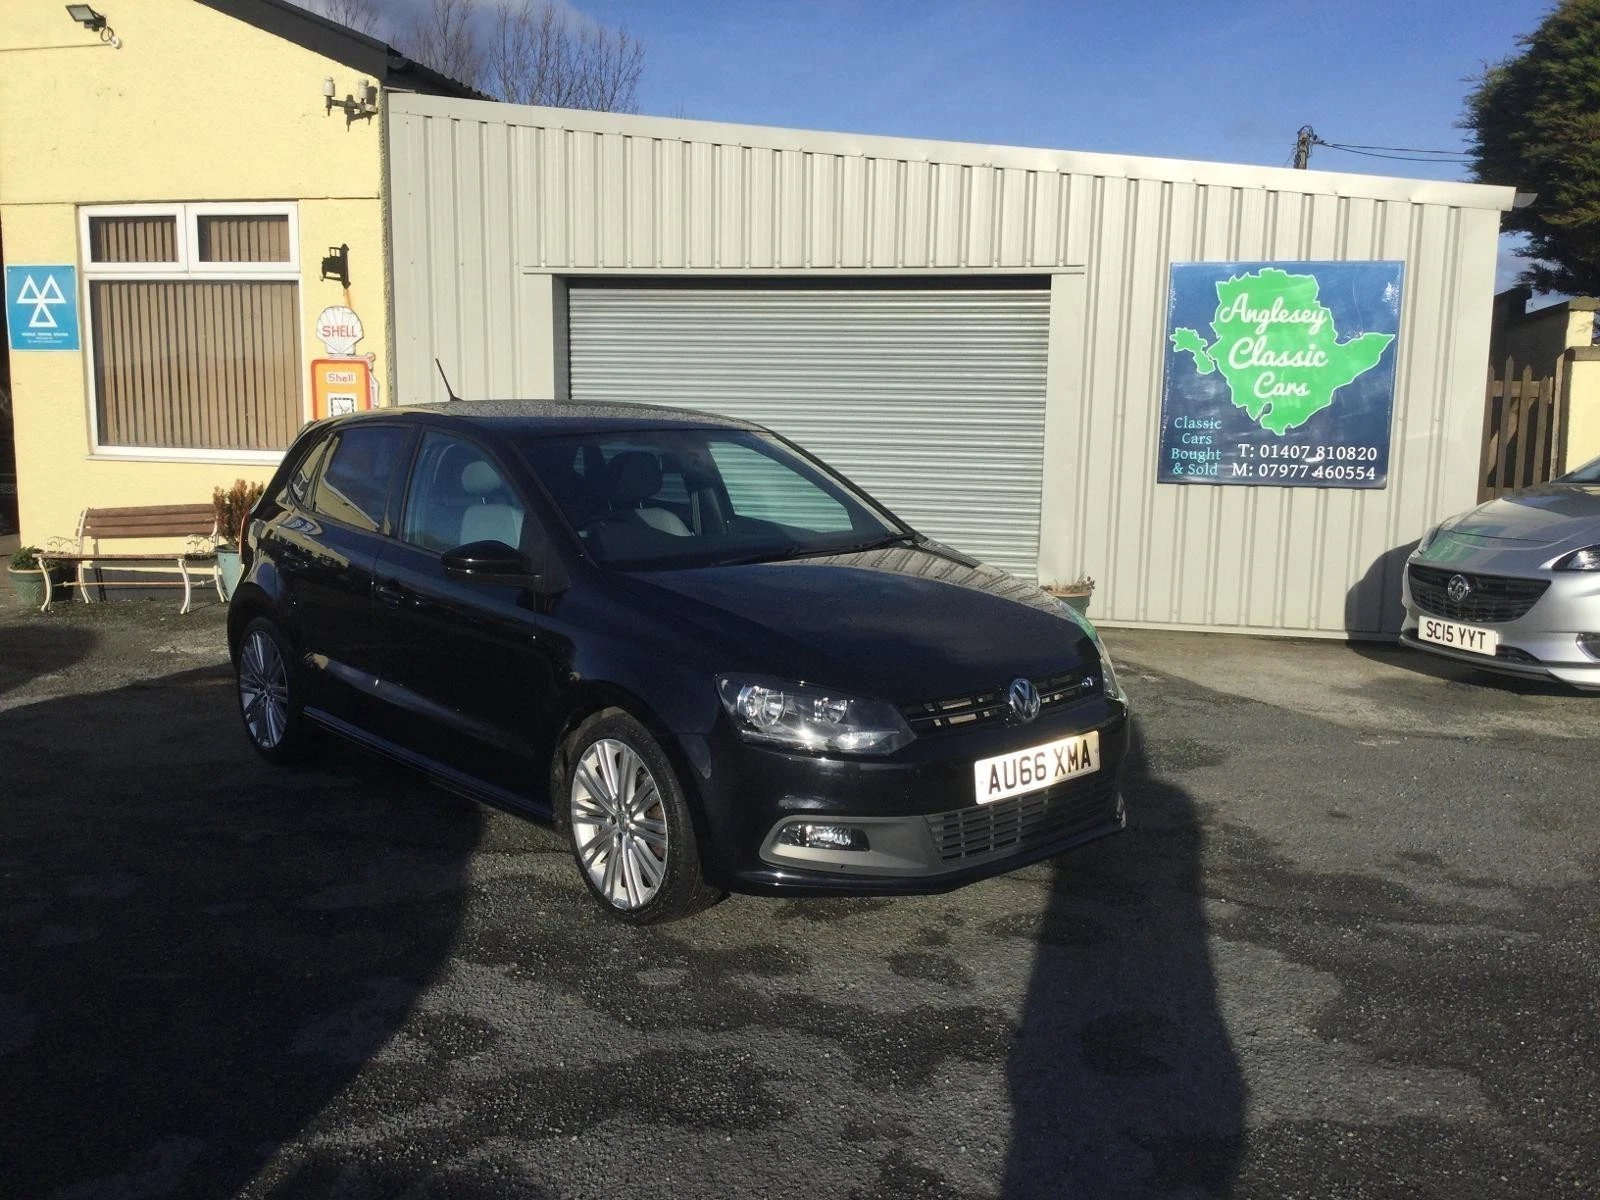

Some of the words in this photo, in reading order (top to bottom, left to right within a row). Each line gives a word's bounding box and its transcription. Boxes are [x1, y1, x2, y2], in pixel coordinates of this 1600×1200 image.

[1220, 293, 1326, 335] Anglesey
[322, 325, 357, 337] SHELL
[1229, 337, 1328, 369] Classic
[328, 373, 354, 382] Shell
[1254, 372, 1310, 398] Cars
[1174, 416, 1222, 430] Classic
[1182, 432, 1212, 445] Cars
[1171, 448, 1221, 462] Bought
[1237, 443, 1255, 459] T:
[1260, 444, 1310, 459] 01407
[1316, 446, 1378, 462] 810820
[1172, 463, 1187, 475] &
[1191, 461, 1218, 475] Sold
[1232, 462, 1253, 477] M:
[1258, 463, 1309, 478] 07977
[1313, 465, 1376, 480] 460554
[1426, 620, 1454, 643] SC15
[1458, 627, 1486, 649] YYT
[988, 752, 1047, 795] AU66
[1053, 739, 1092, 778] XMA
